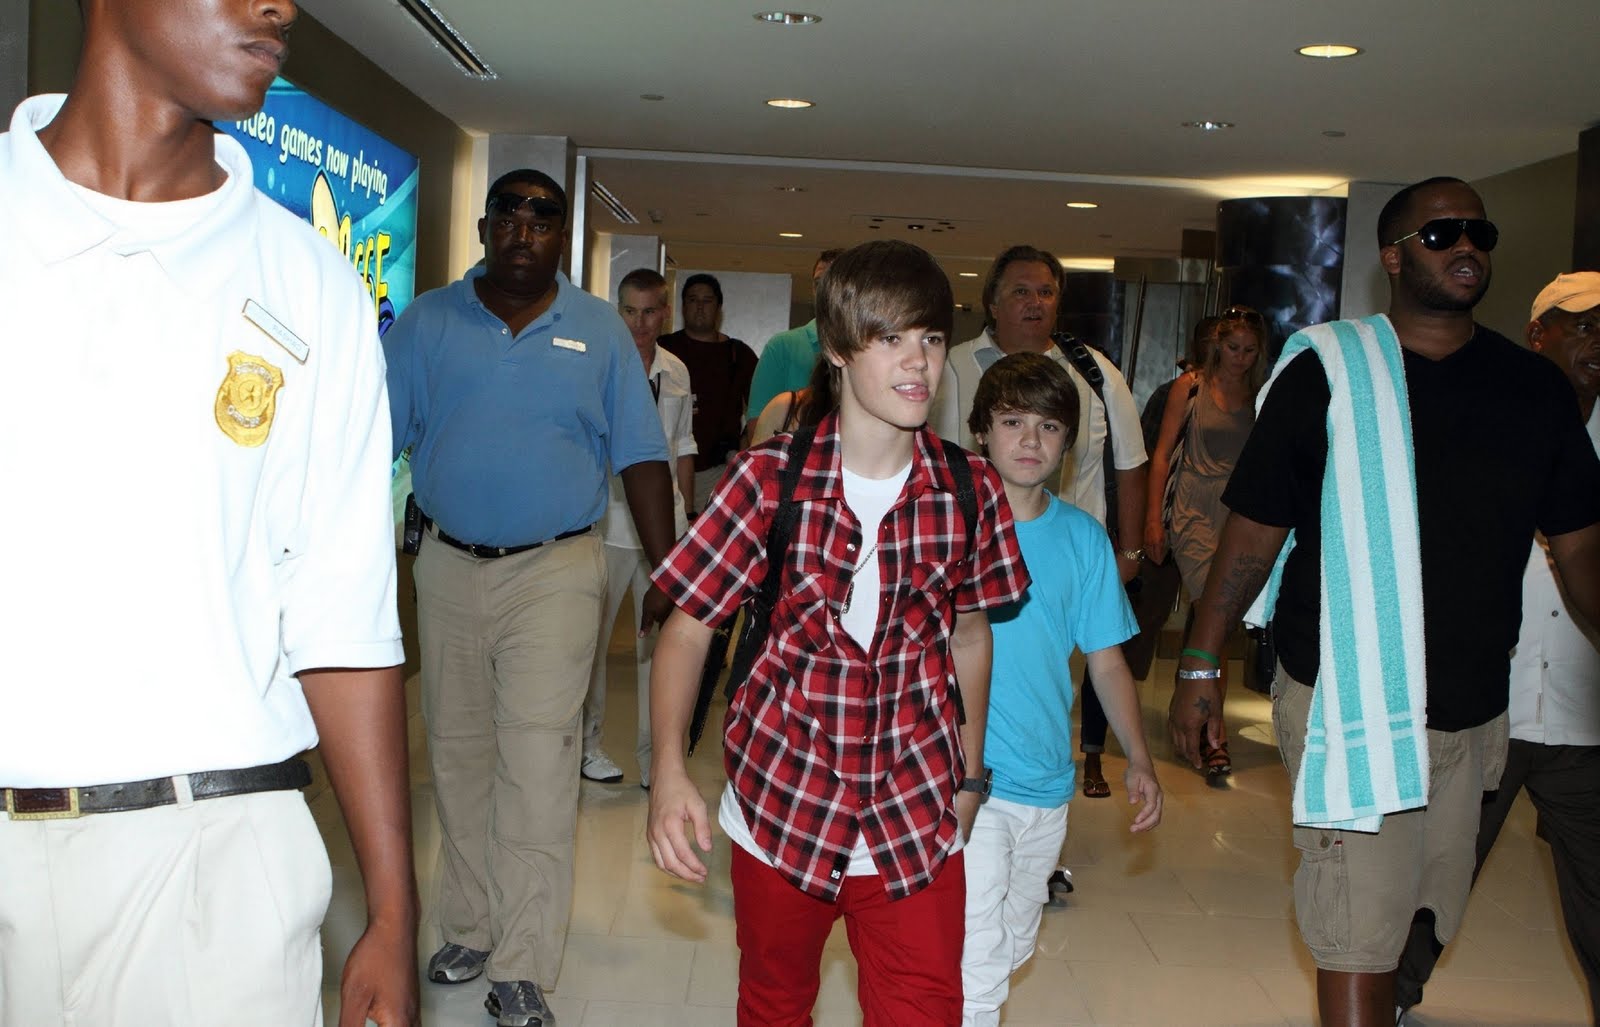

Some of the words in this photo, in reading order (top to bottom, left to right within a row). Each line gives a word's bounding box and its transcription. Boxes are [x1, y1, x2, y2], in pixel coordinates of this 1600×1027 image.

[279, 124, 322, 167] games
[326, 143, 349, 181] now
[351, 150, 388, 205] playing
